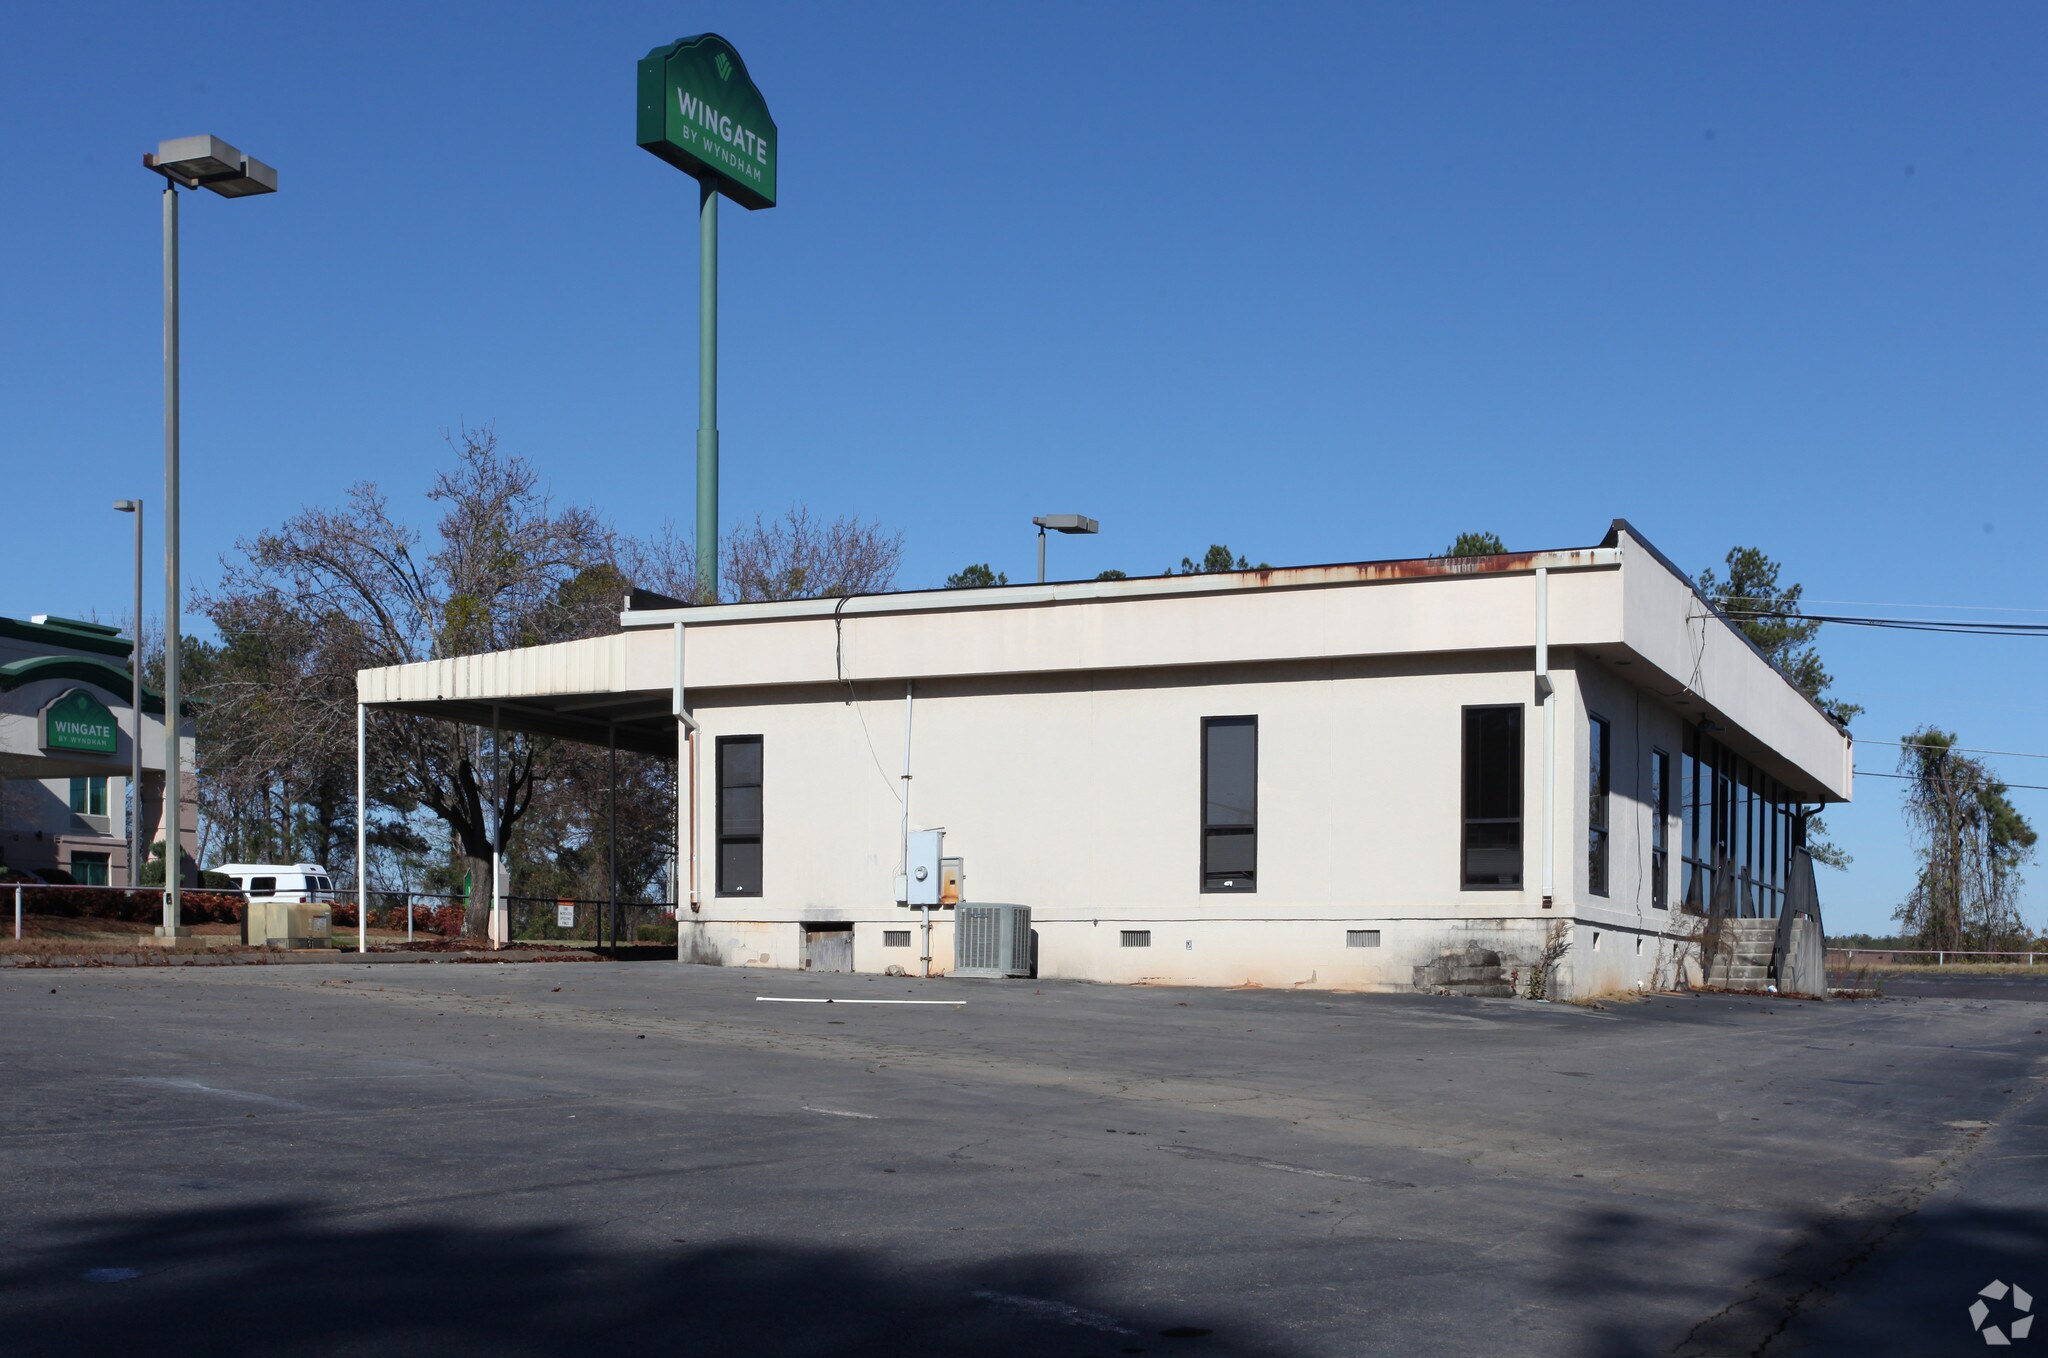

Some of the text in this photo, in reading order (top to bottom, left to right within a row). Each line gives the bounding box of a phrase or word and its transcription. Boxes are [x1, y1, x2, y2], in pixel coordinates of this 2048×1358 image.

[677, 87, 767, 165] WINGATE
[683, 125, 761, 183] BY WYNDHAM
[55, 720, 110, 738] WINGATE
[70, 736, 107, 746] WYNDHAM
